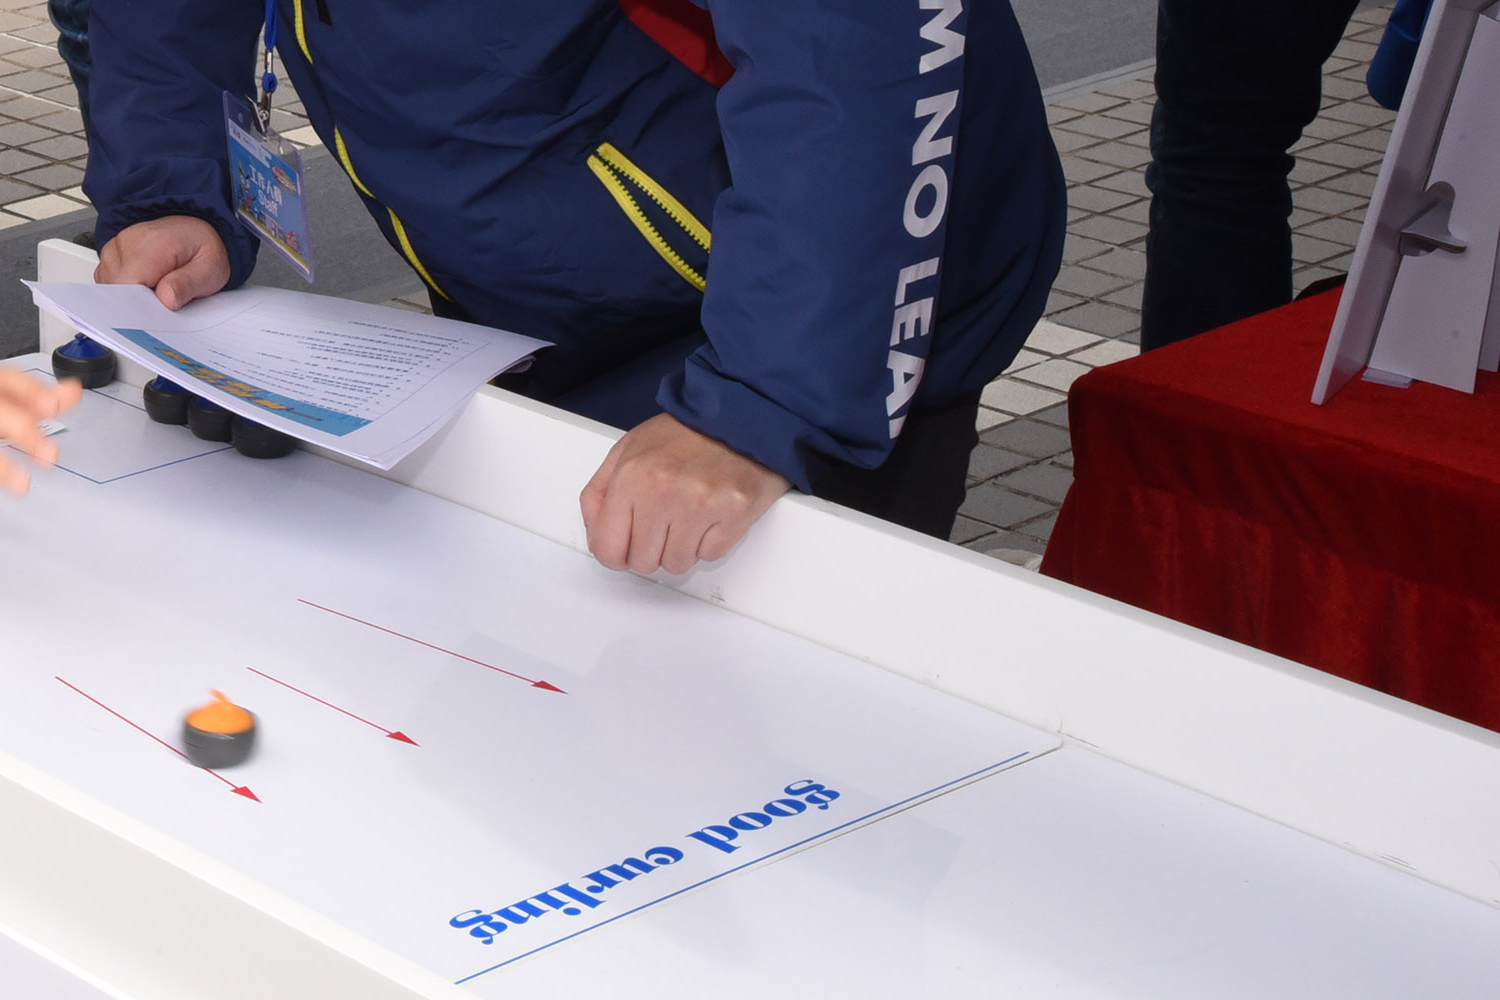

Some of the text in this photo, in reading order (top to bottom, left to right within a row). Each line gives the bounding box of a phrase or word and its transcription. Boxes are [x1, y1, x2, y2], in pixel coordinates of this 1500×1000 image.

[258, 189, 278, 218] Staff
[902, 89, 959, 239] NO
[448, 779, 841, 946] good curling
